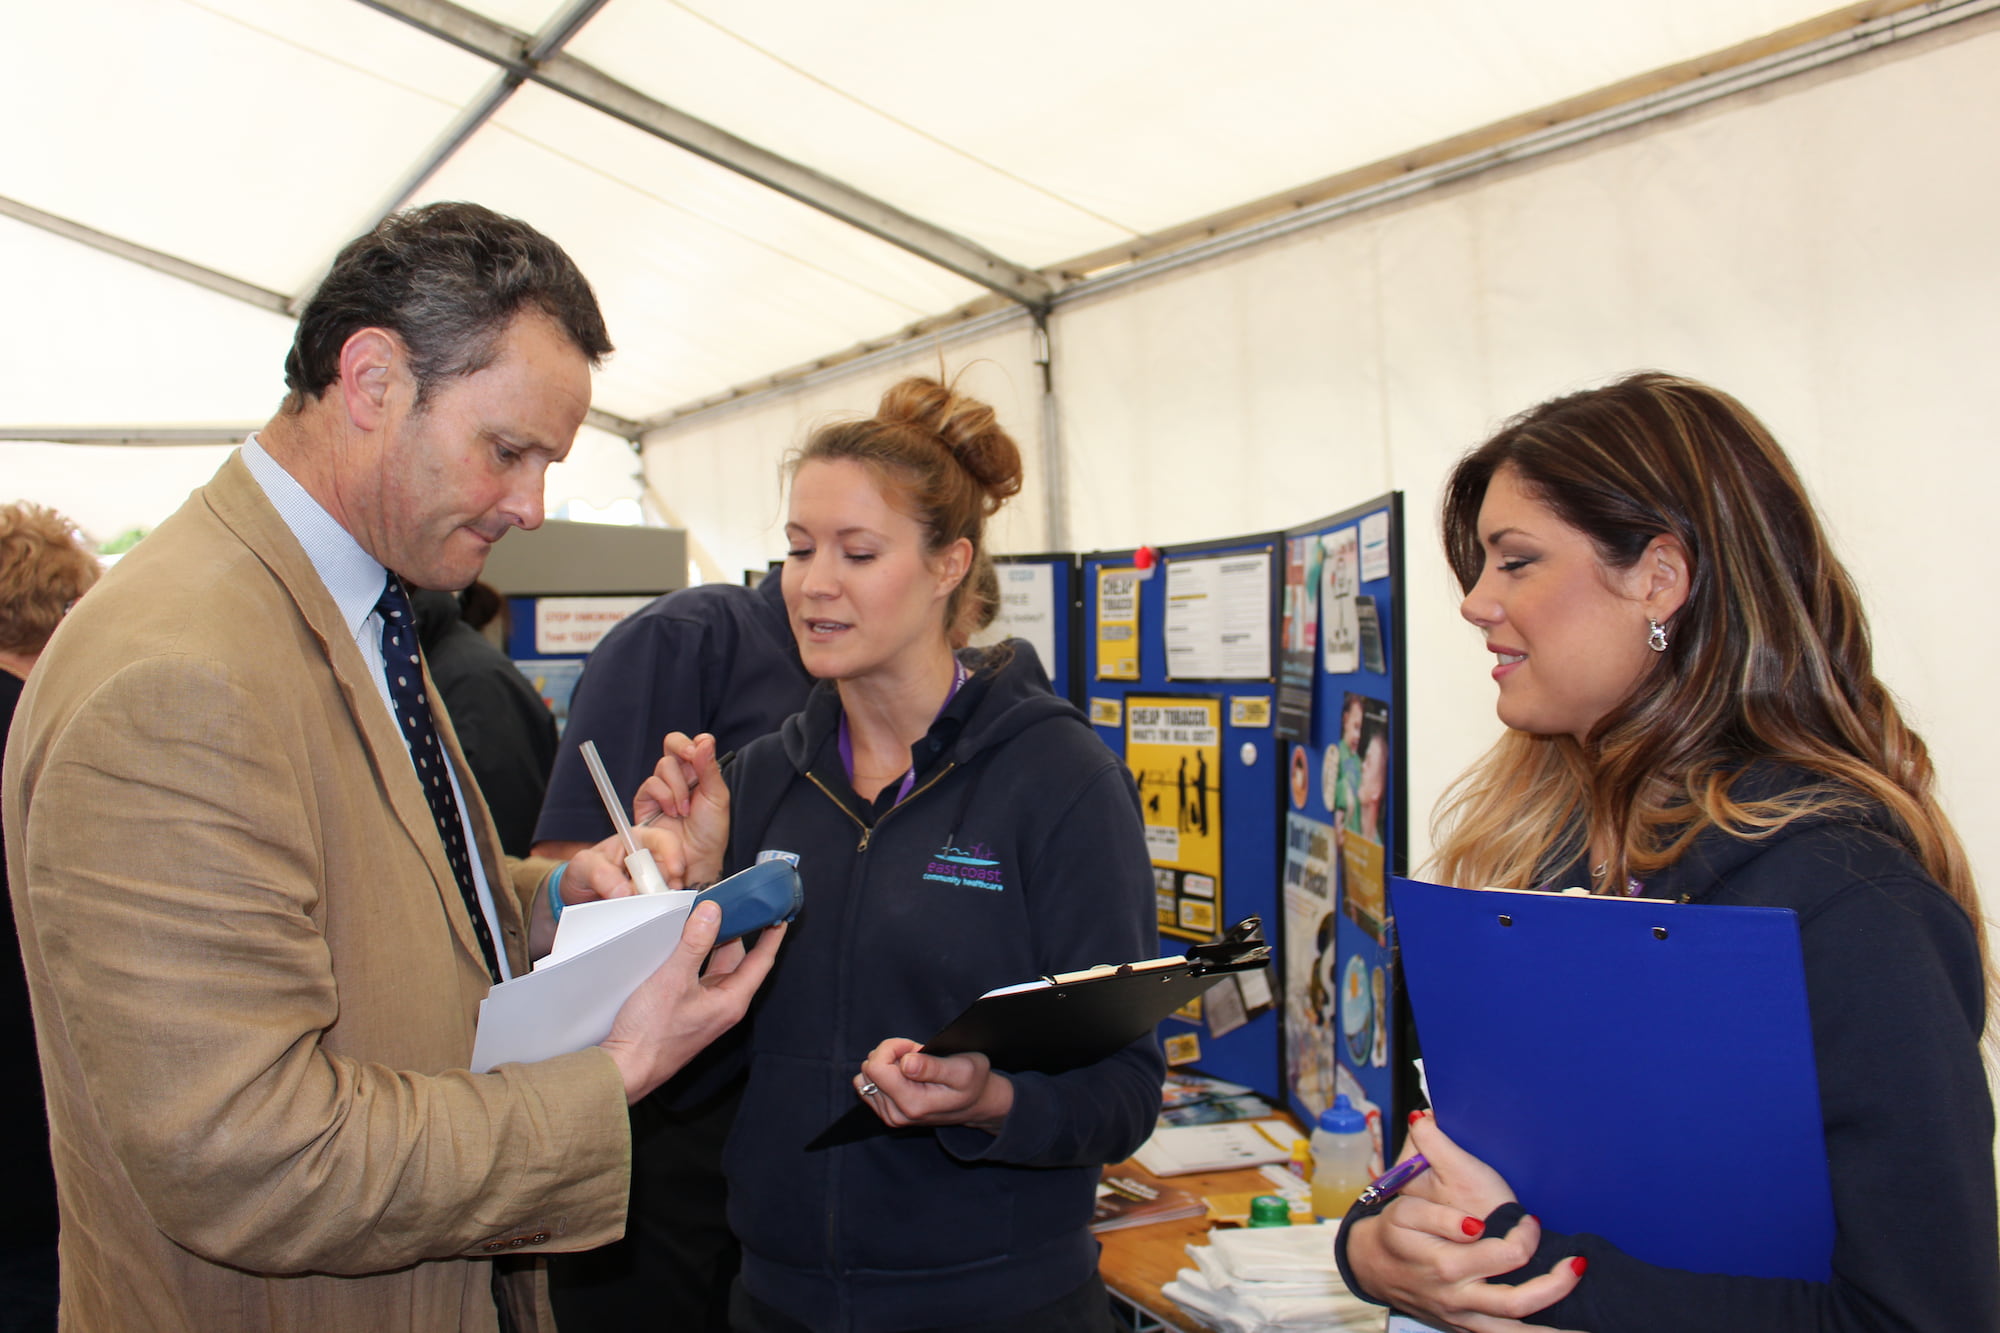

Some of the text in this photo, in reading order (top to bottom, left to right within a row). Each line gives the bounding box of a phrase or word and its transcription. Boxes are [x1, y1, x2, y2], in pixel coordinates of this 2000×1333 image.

[1103, 578, 1133, 595] CHEAP
[1132, 709, 1159, 726] CHEAP
[1163, 709, 1206, 726] TOBACCO
[927, 861, 1003, 882] east coast
[922, 872, 1004, 892] community healthcare
